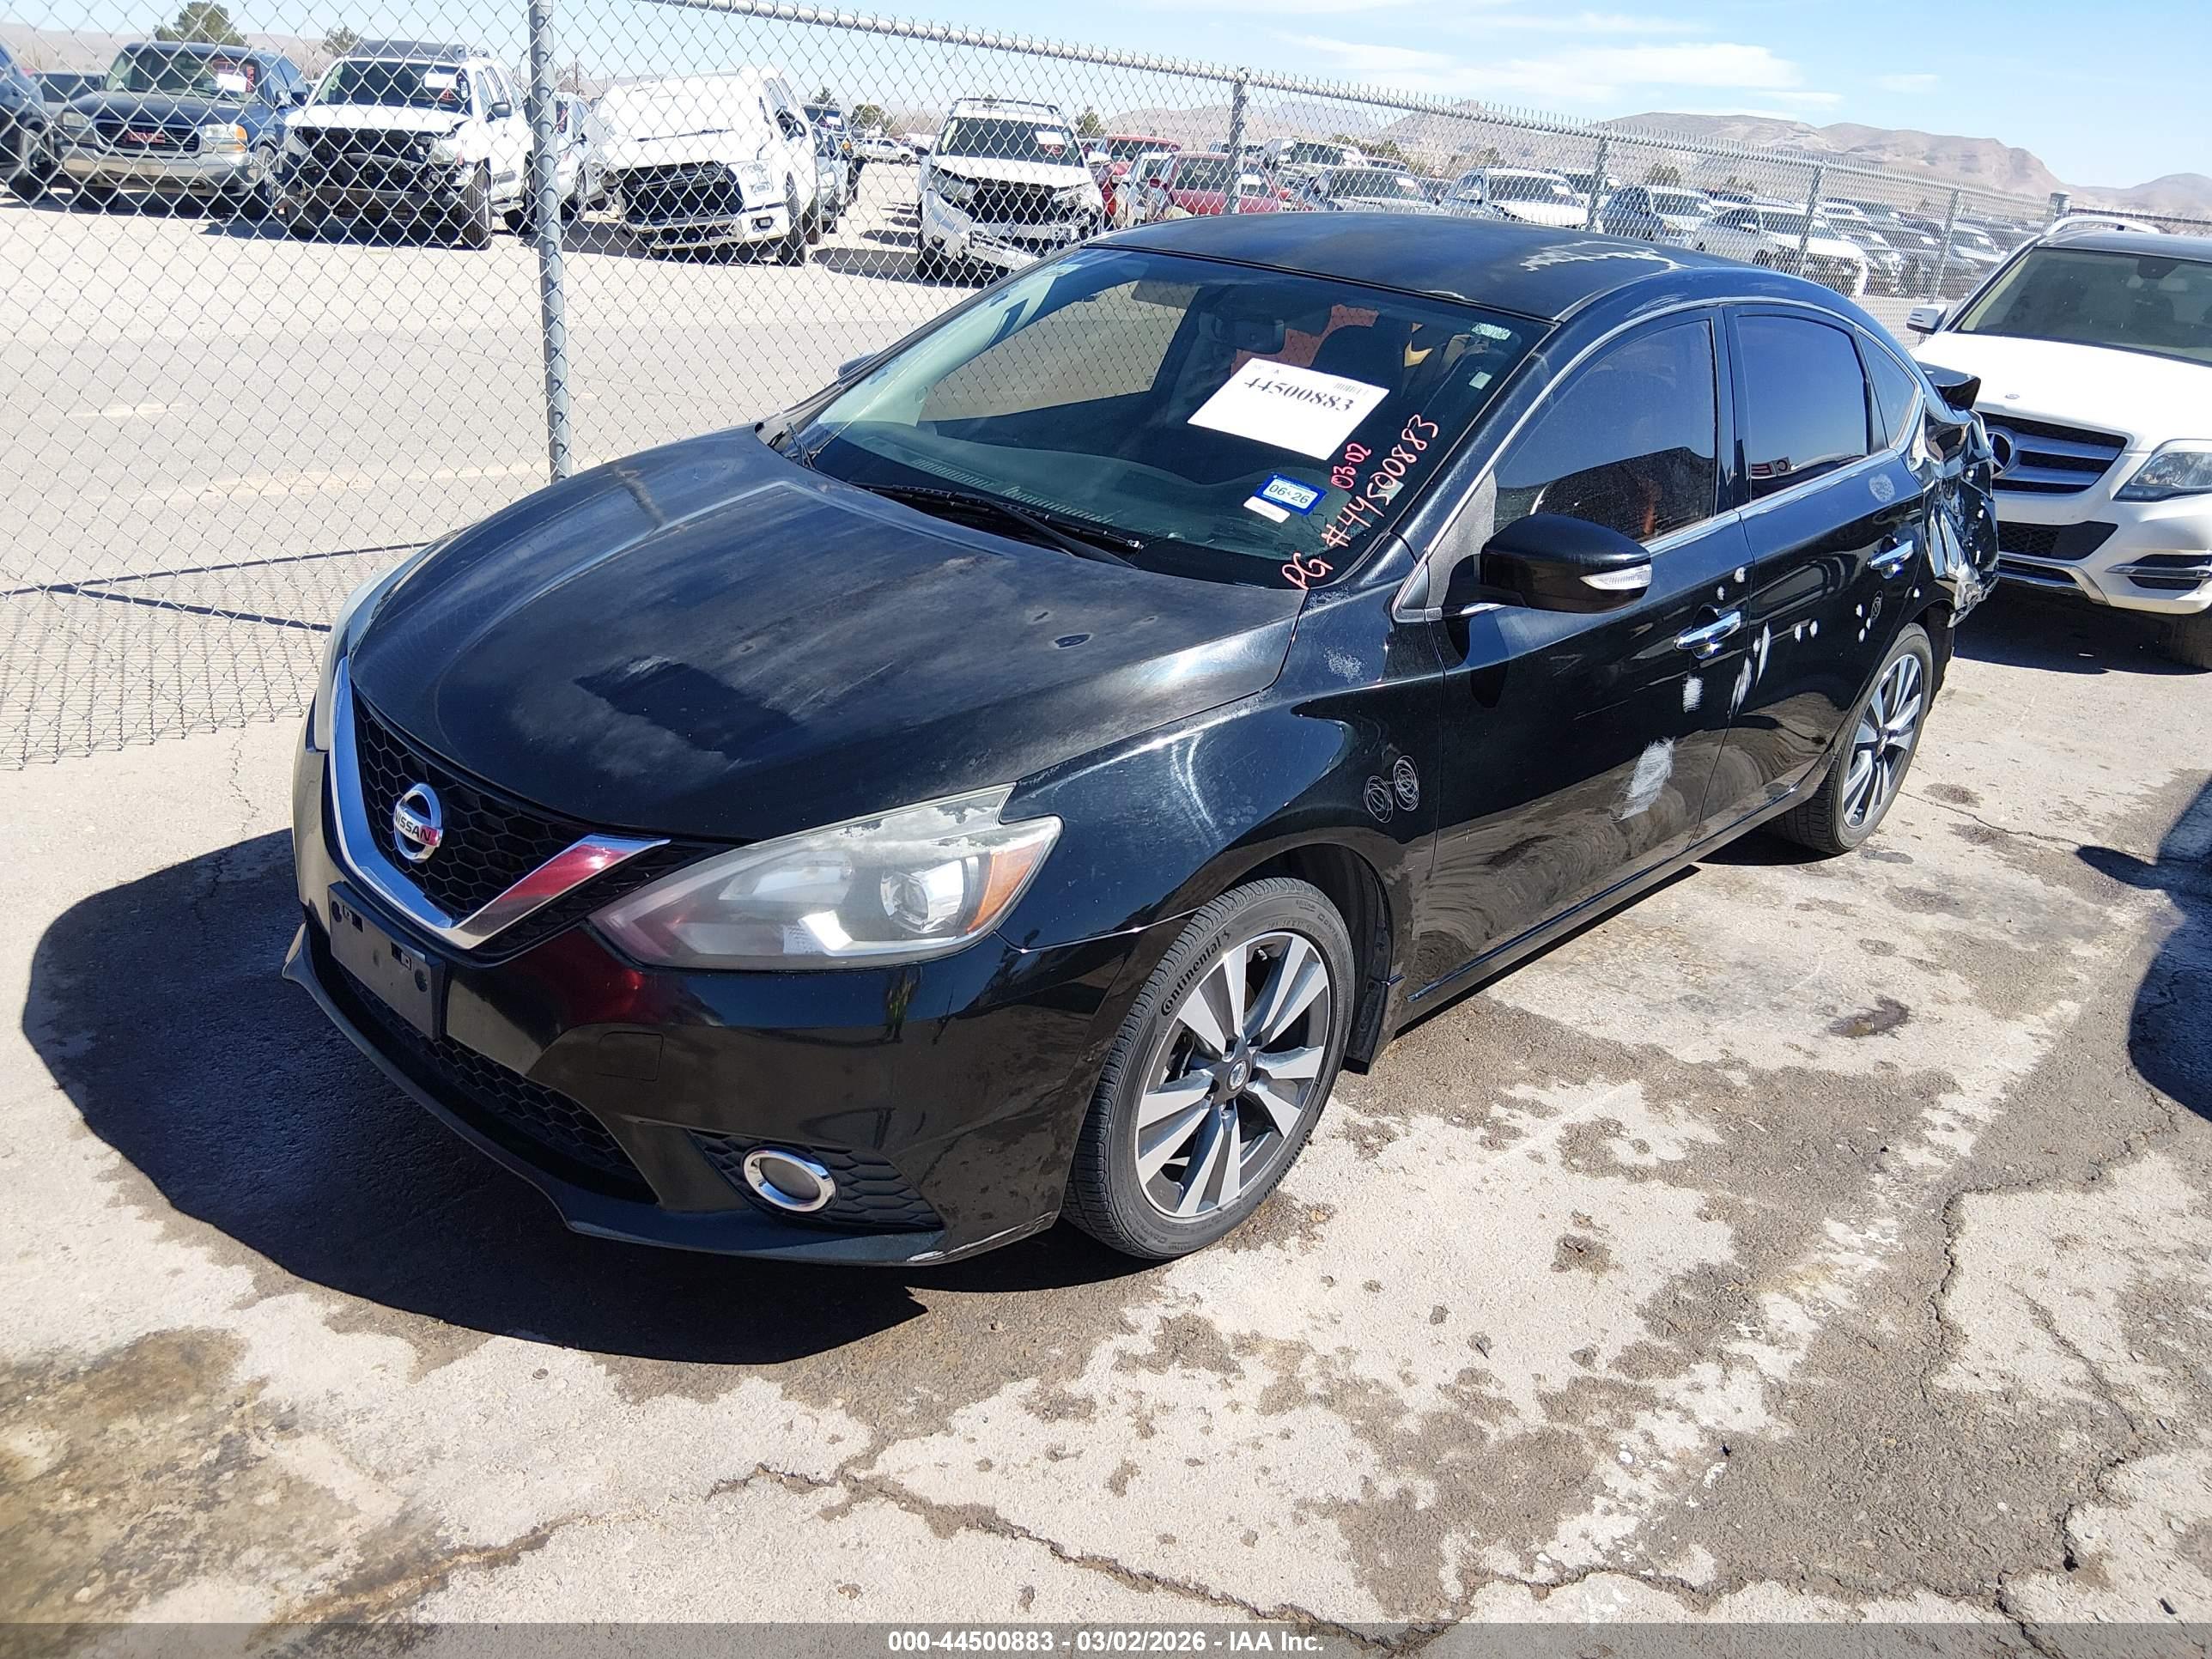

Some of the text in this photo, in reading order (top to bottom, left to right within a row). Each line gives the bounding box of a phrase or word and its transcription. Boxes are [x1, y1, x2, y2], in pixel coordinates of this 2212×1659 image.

[1244, 377, 1354, 411] 44500883
[1331, 442, 1372, 489] 03-02
[394, 809, 432, 842] NISSAN
[1161, 935, 1222, 1017] Continental
